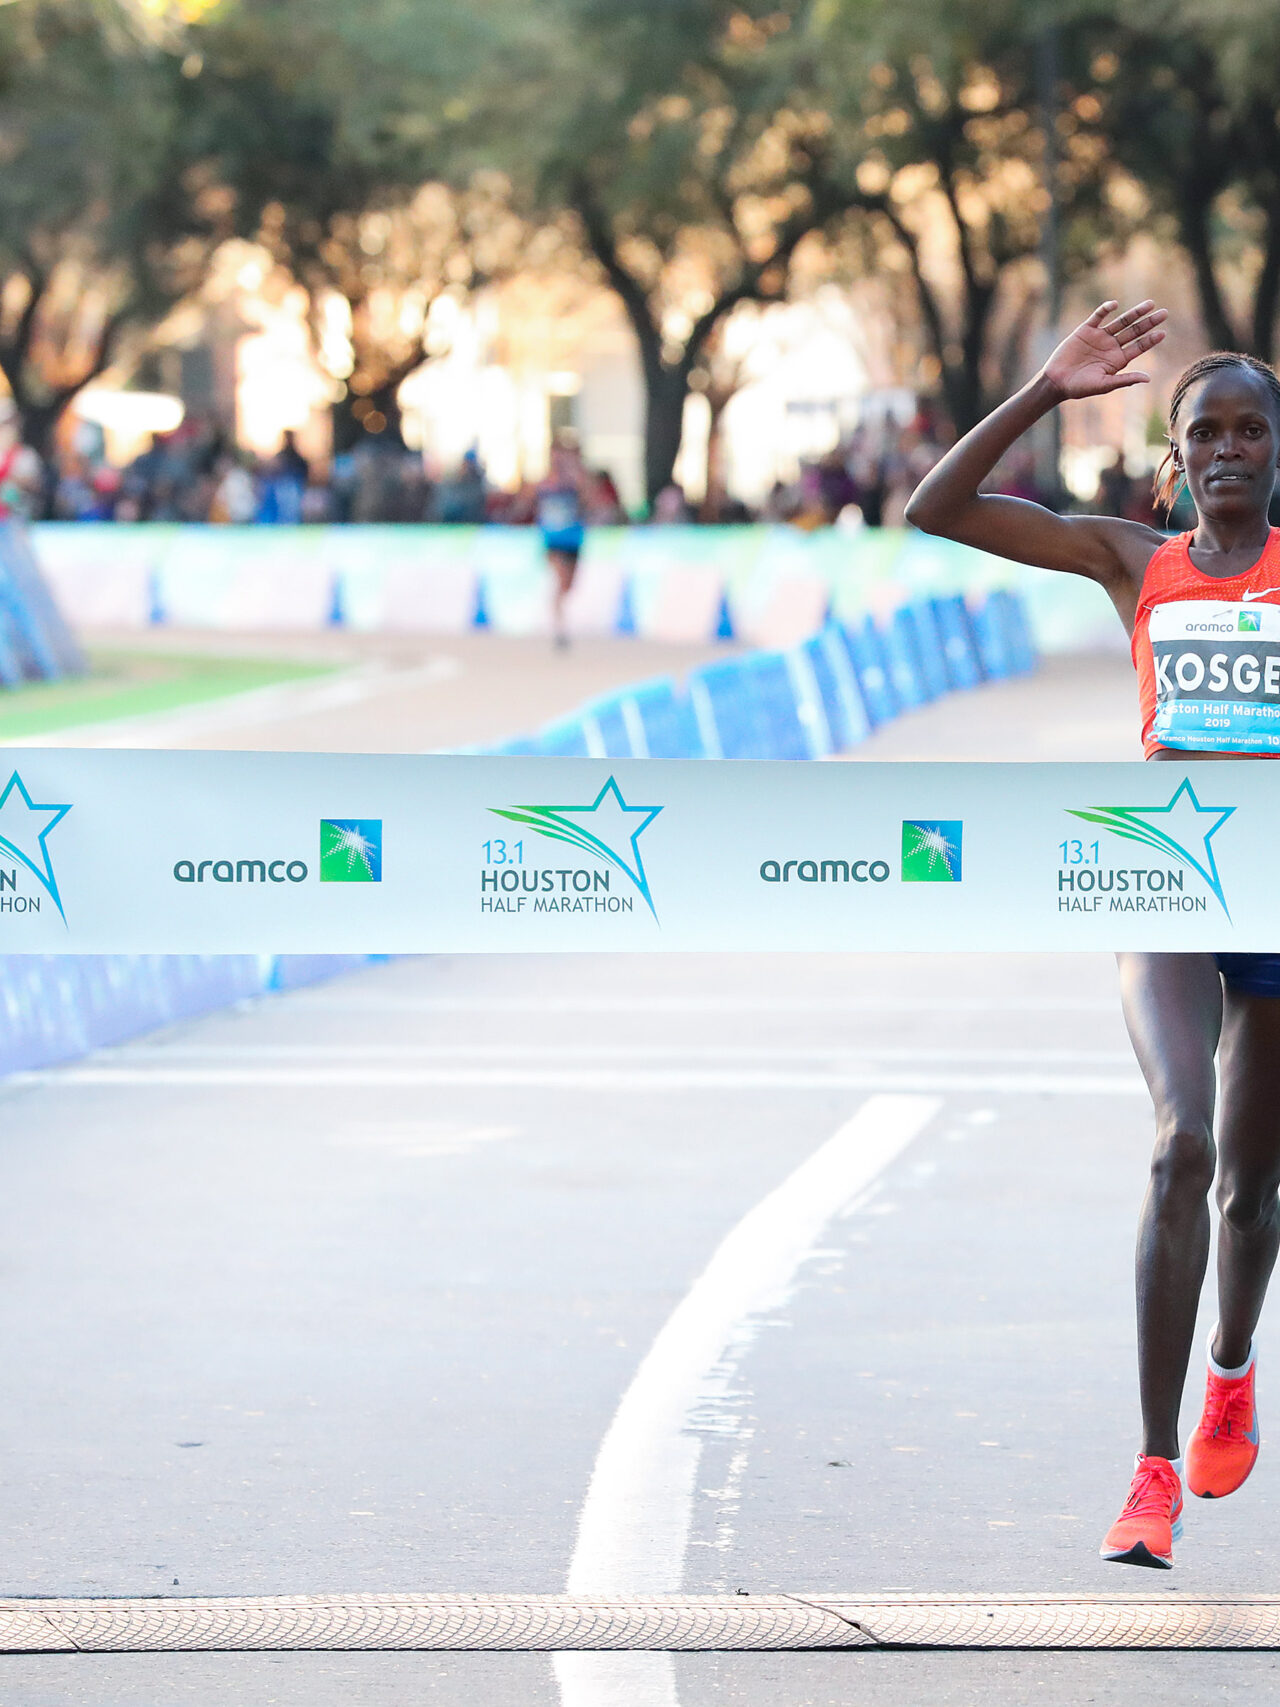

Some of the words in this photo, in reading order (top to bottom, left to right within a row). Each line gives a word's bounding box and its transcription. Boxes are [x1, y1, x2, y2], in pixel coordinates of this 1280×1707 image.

[1185, 623, 1234, 633] aramco
[1203, 704, 1230, 715] Half
[1204, 718, 1231, 727] 2019
[481, 839, 523, 865] 13.1
[1058, 840, 1100, 865] 13.1
[173, 860, 308, 883] aramco
[481, 869, 610, 893] HOUSTON
[760, 860, 890, 883] aramco
[1058, 869, 1184, 892] HOUSTON
[481, 897, 527, 913] HALF
[533, 897, 633, 913] MARATHON
[1058, 896, 1104, 912] HALF
[1109, 896, 1207, 912] MARATHON
